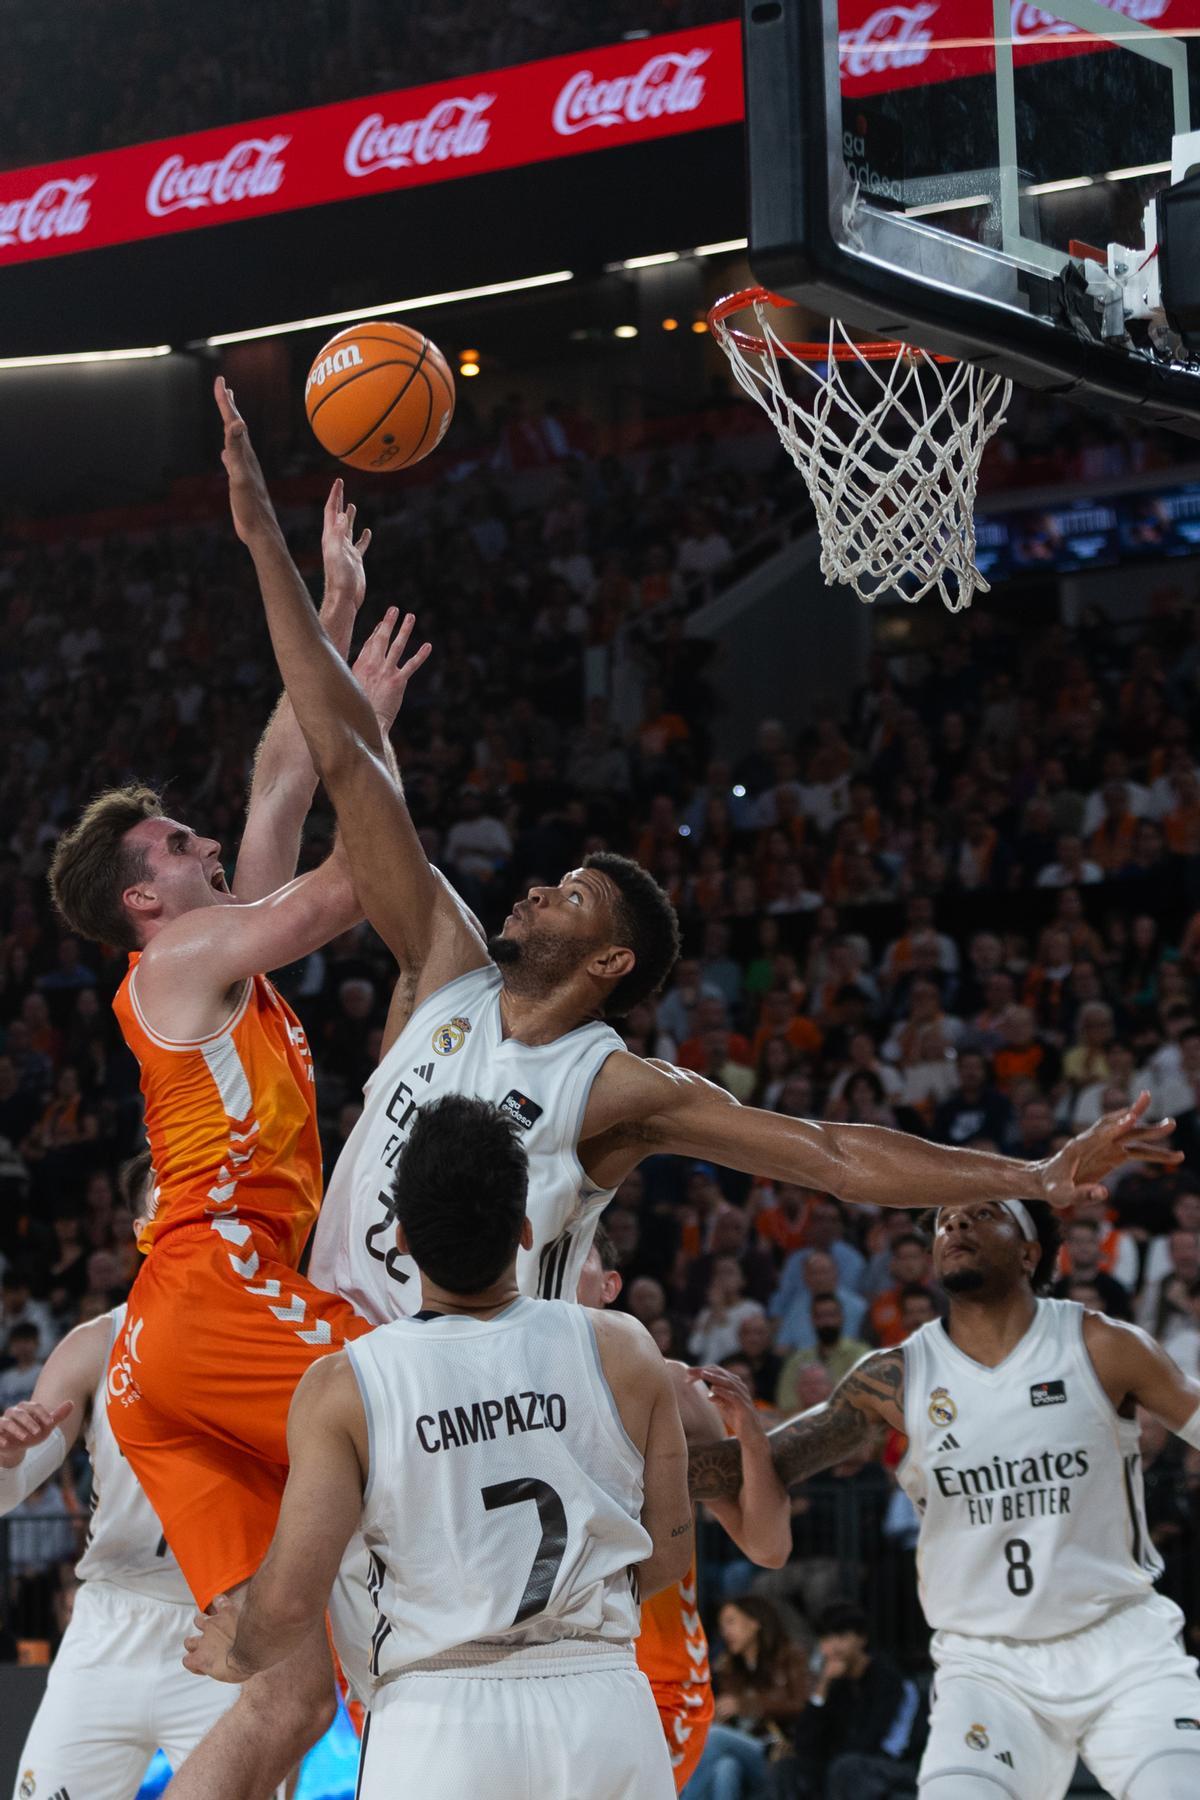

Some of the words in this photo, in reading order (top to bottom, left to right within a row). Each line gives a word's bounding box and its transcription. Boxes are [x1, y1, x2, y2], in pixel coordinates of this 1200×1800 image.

[843, 132, 865, 158] ga
[847, 161, 902, 200] ndesa
[502, 1104, 532, 1127] endesa
[933, 1450, 1089, 1498] Emirates
[968, 1498, 994, 1526] FLY
[1002, 1486, 1071, 1522] BETTER
[481, 1477, 568, 1626] 7
[1004, 1538, 1034, 1597] 8
